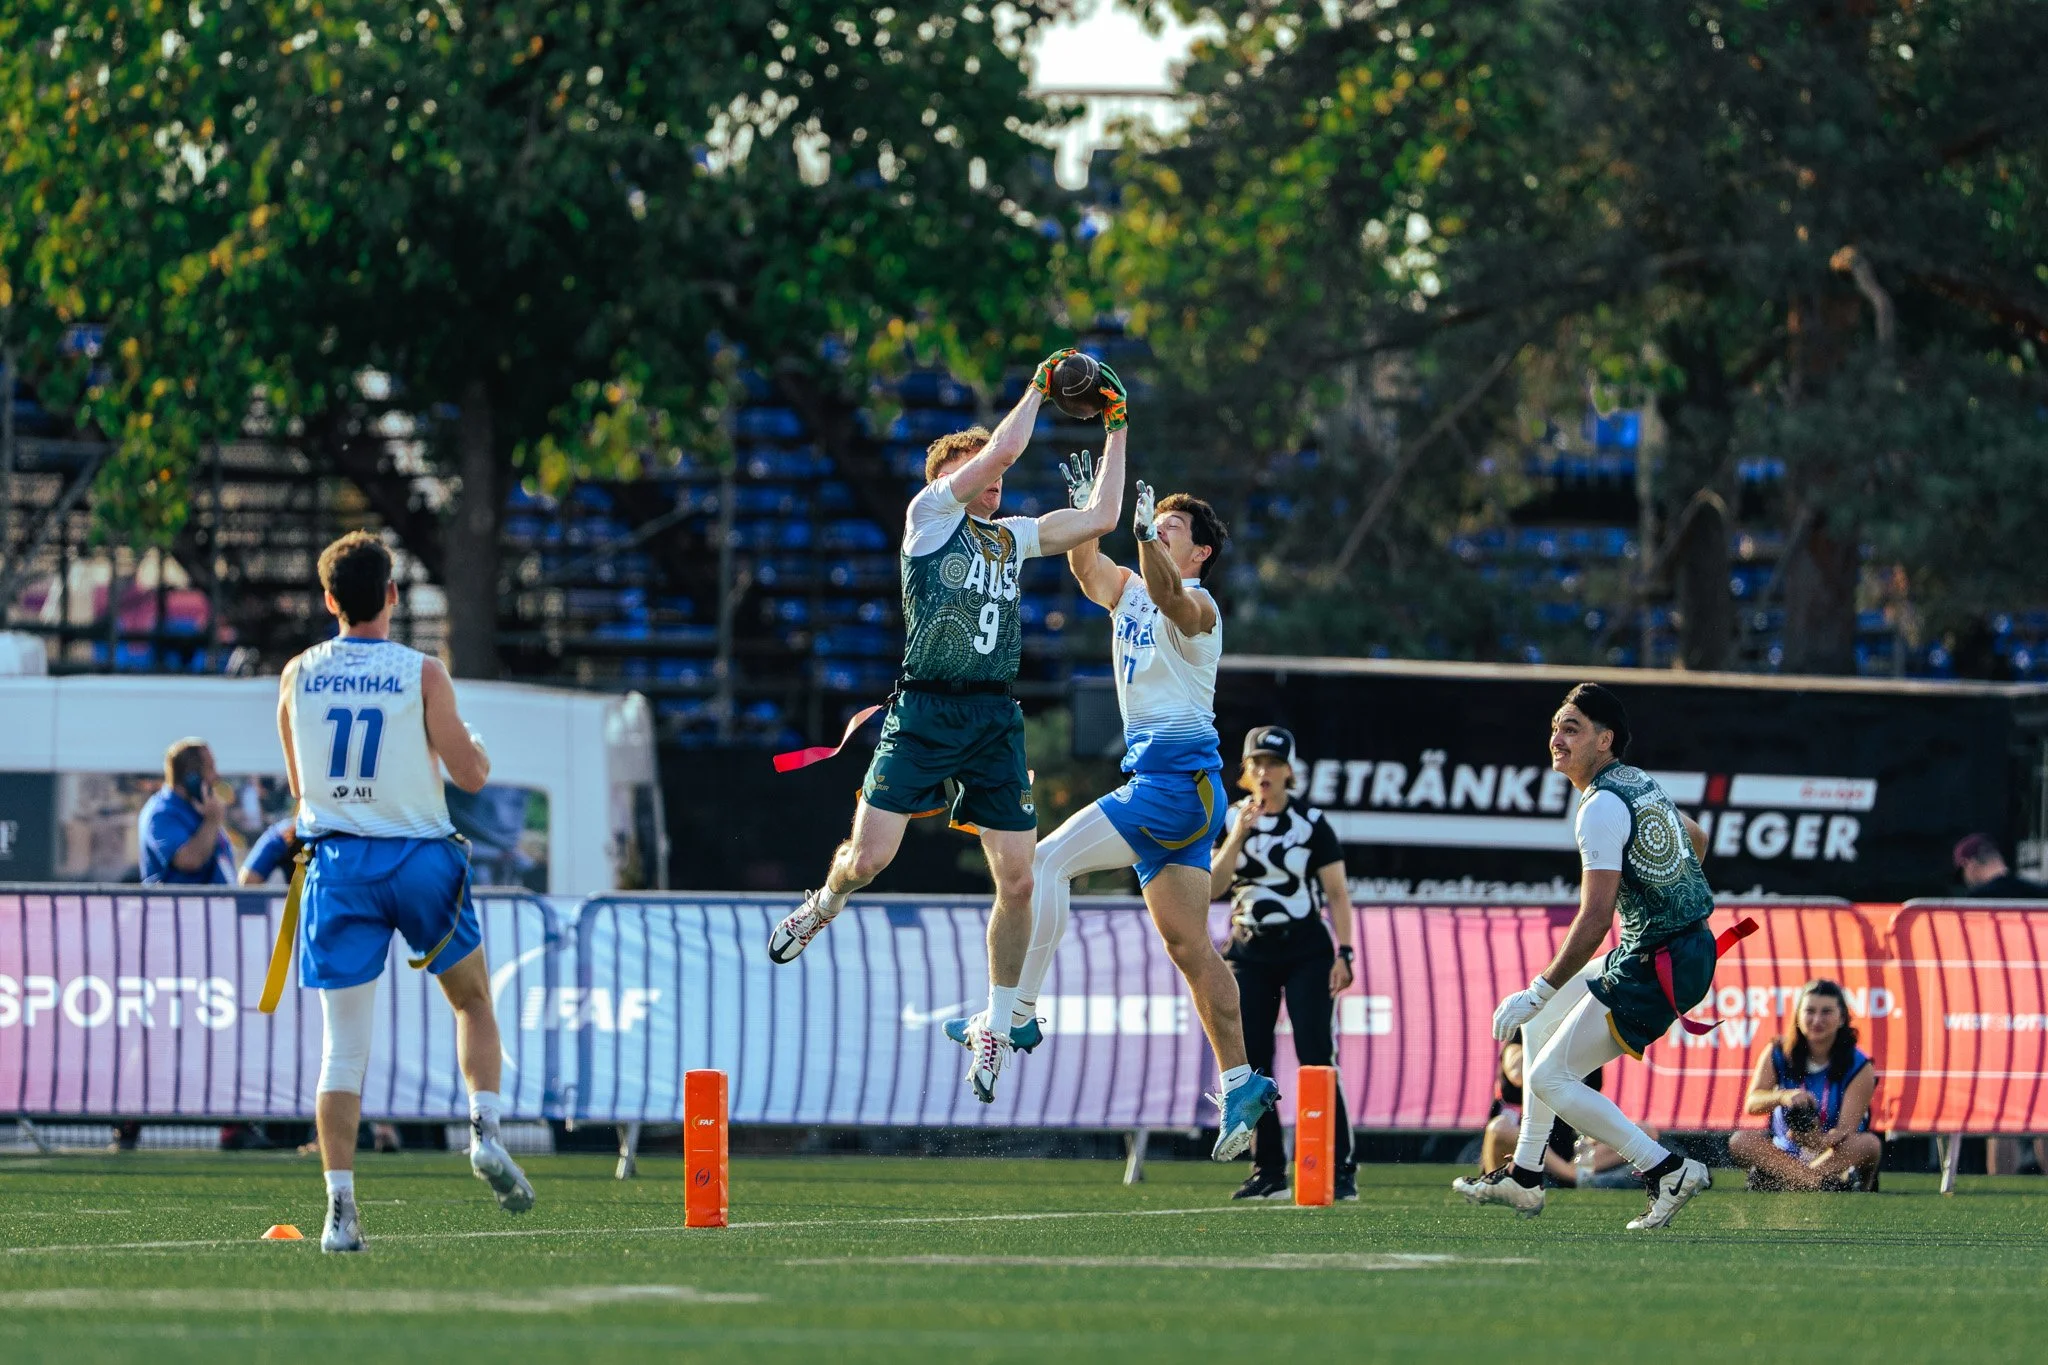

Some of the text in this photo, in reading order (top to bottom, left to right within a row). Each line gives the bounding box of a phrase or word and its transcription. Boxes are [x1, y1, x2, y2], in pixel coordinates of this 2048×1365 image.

[963, 552, 1017, 602] AUS
[973, 601, 1000, 655] 9
[305, 675, 403, 693] LEVENTHAL
[325, 706, 385, 779] 11
[520, 985, 663, 1032] IFAF
